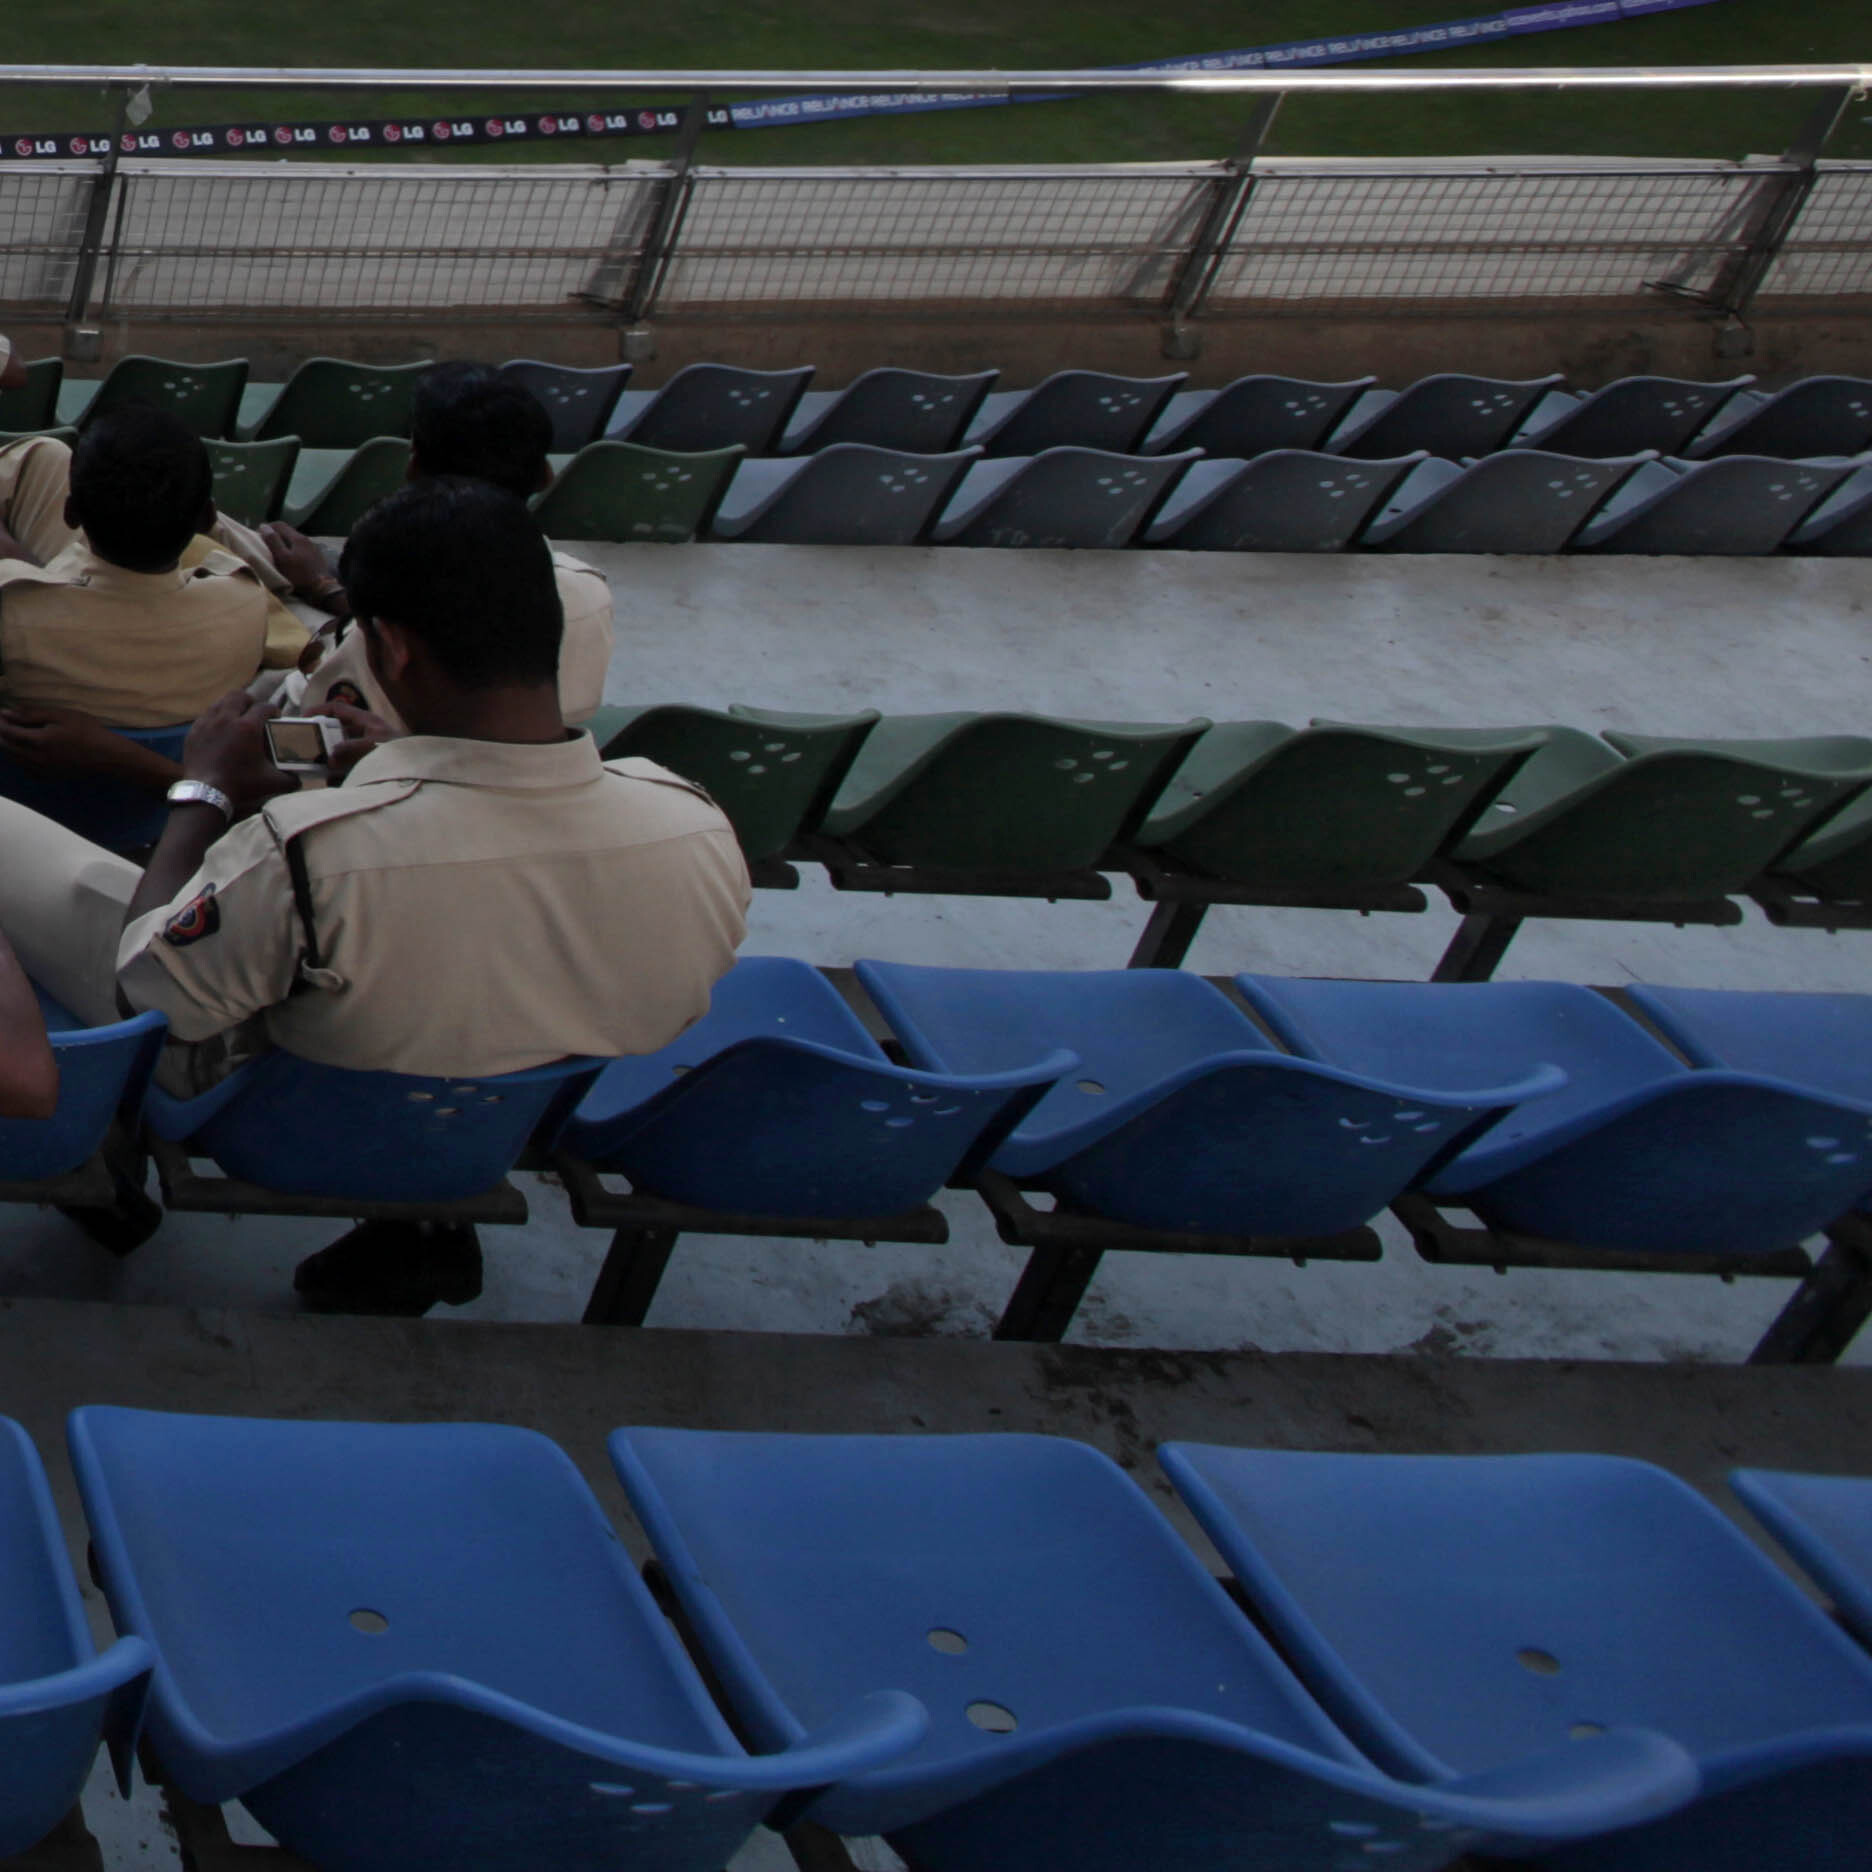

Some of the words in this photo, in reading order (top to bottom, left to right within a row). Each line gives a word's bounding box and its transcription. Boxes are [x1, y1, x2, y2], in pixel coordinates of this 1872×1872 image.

[606, 115, 627, 128] LG
[657, 113, 678, 126] LG
[708, 110, 729, 123] LG
[452, 123, 473, 136] LG
[505, 120, 526, 133] LG
[558, 118, 579, 131] LG
[246, 129, 267, 142] LG
[294, 128, 316, 141] LG
[348, 128, 370, 140] LG
[403, 126, 424, 138] LG
[139, 136, 160, 148] LG
[192, 133, 214, 145] LG
[35, 141, 56, 153] LG
[89, 140, 111, 152] LG
